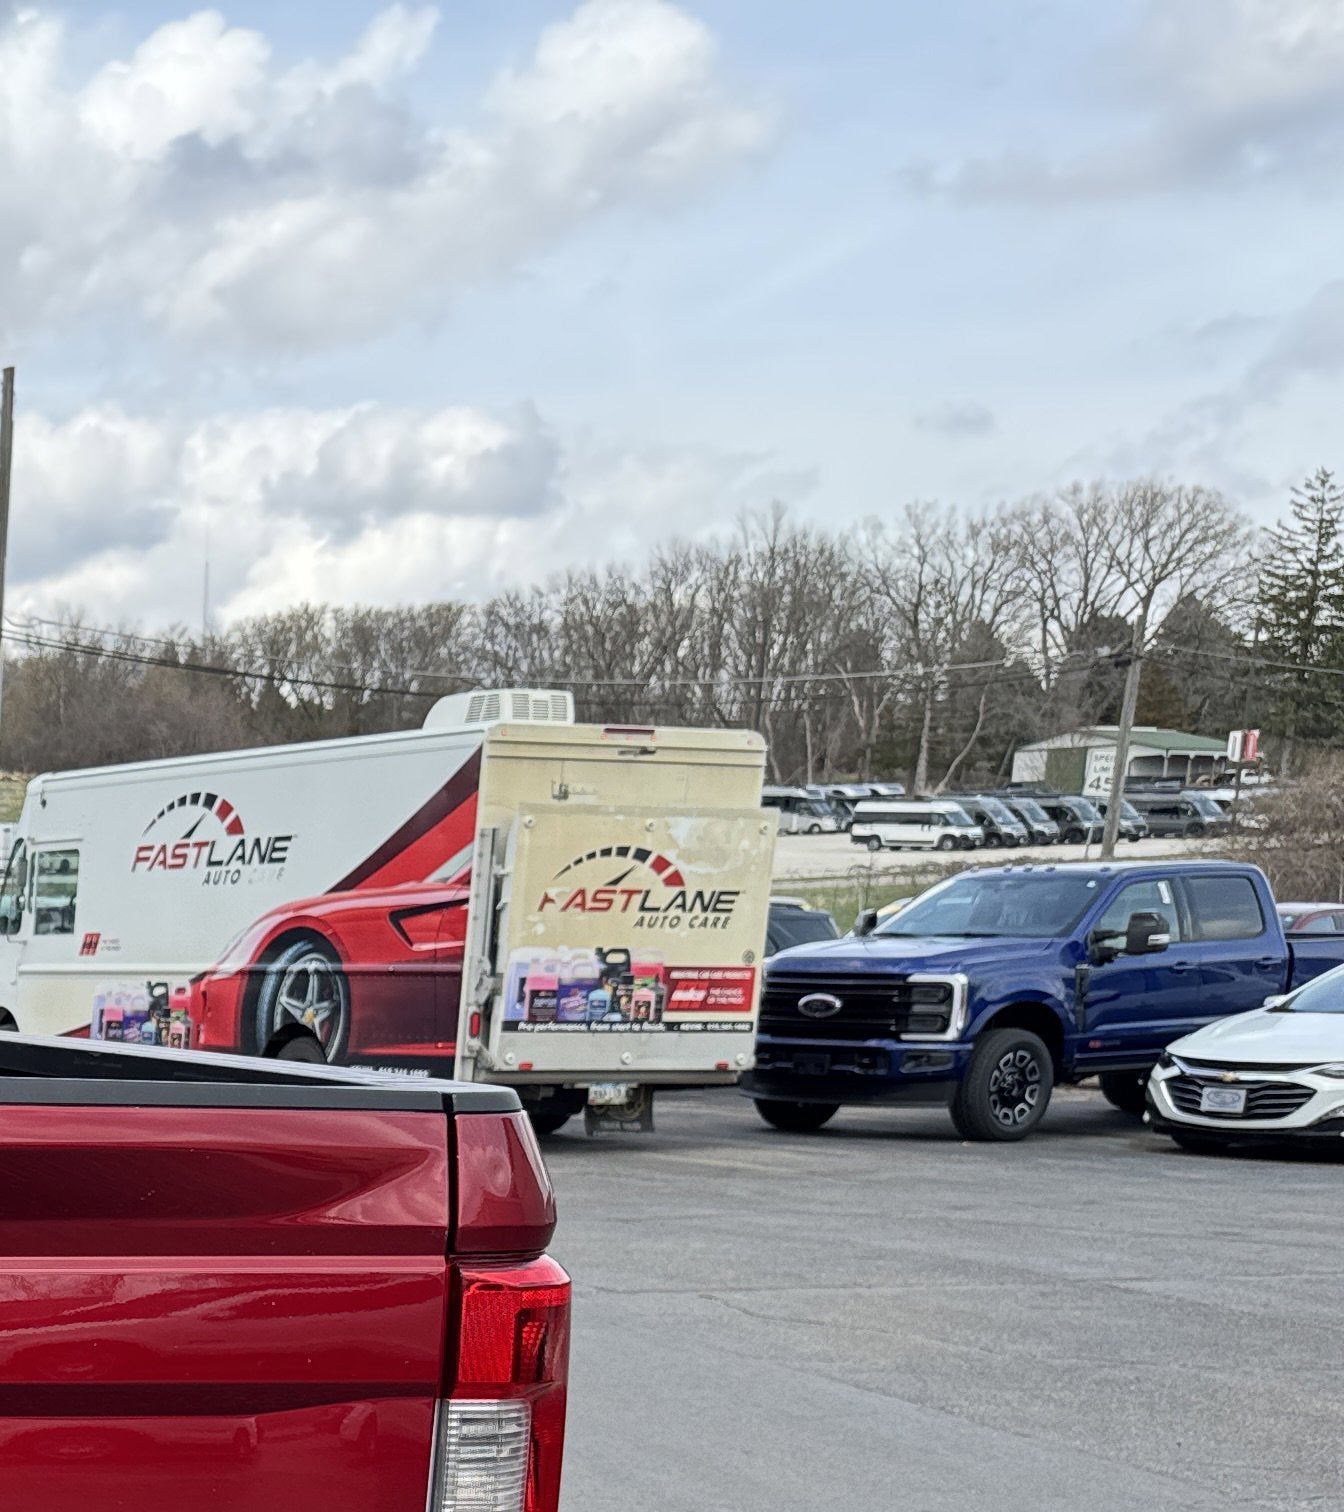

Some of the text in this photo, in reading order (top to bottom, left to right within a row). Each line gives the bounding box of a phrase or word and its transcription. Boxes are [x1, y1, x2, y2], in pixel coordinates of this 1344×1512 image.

[131, 835, 293, 873] FASTLANE
[202, 869, 241, 886] AUTO
[633, 915, 731, 929] AUTO CARE
